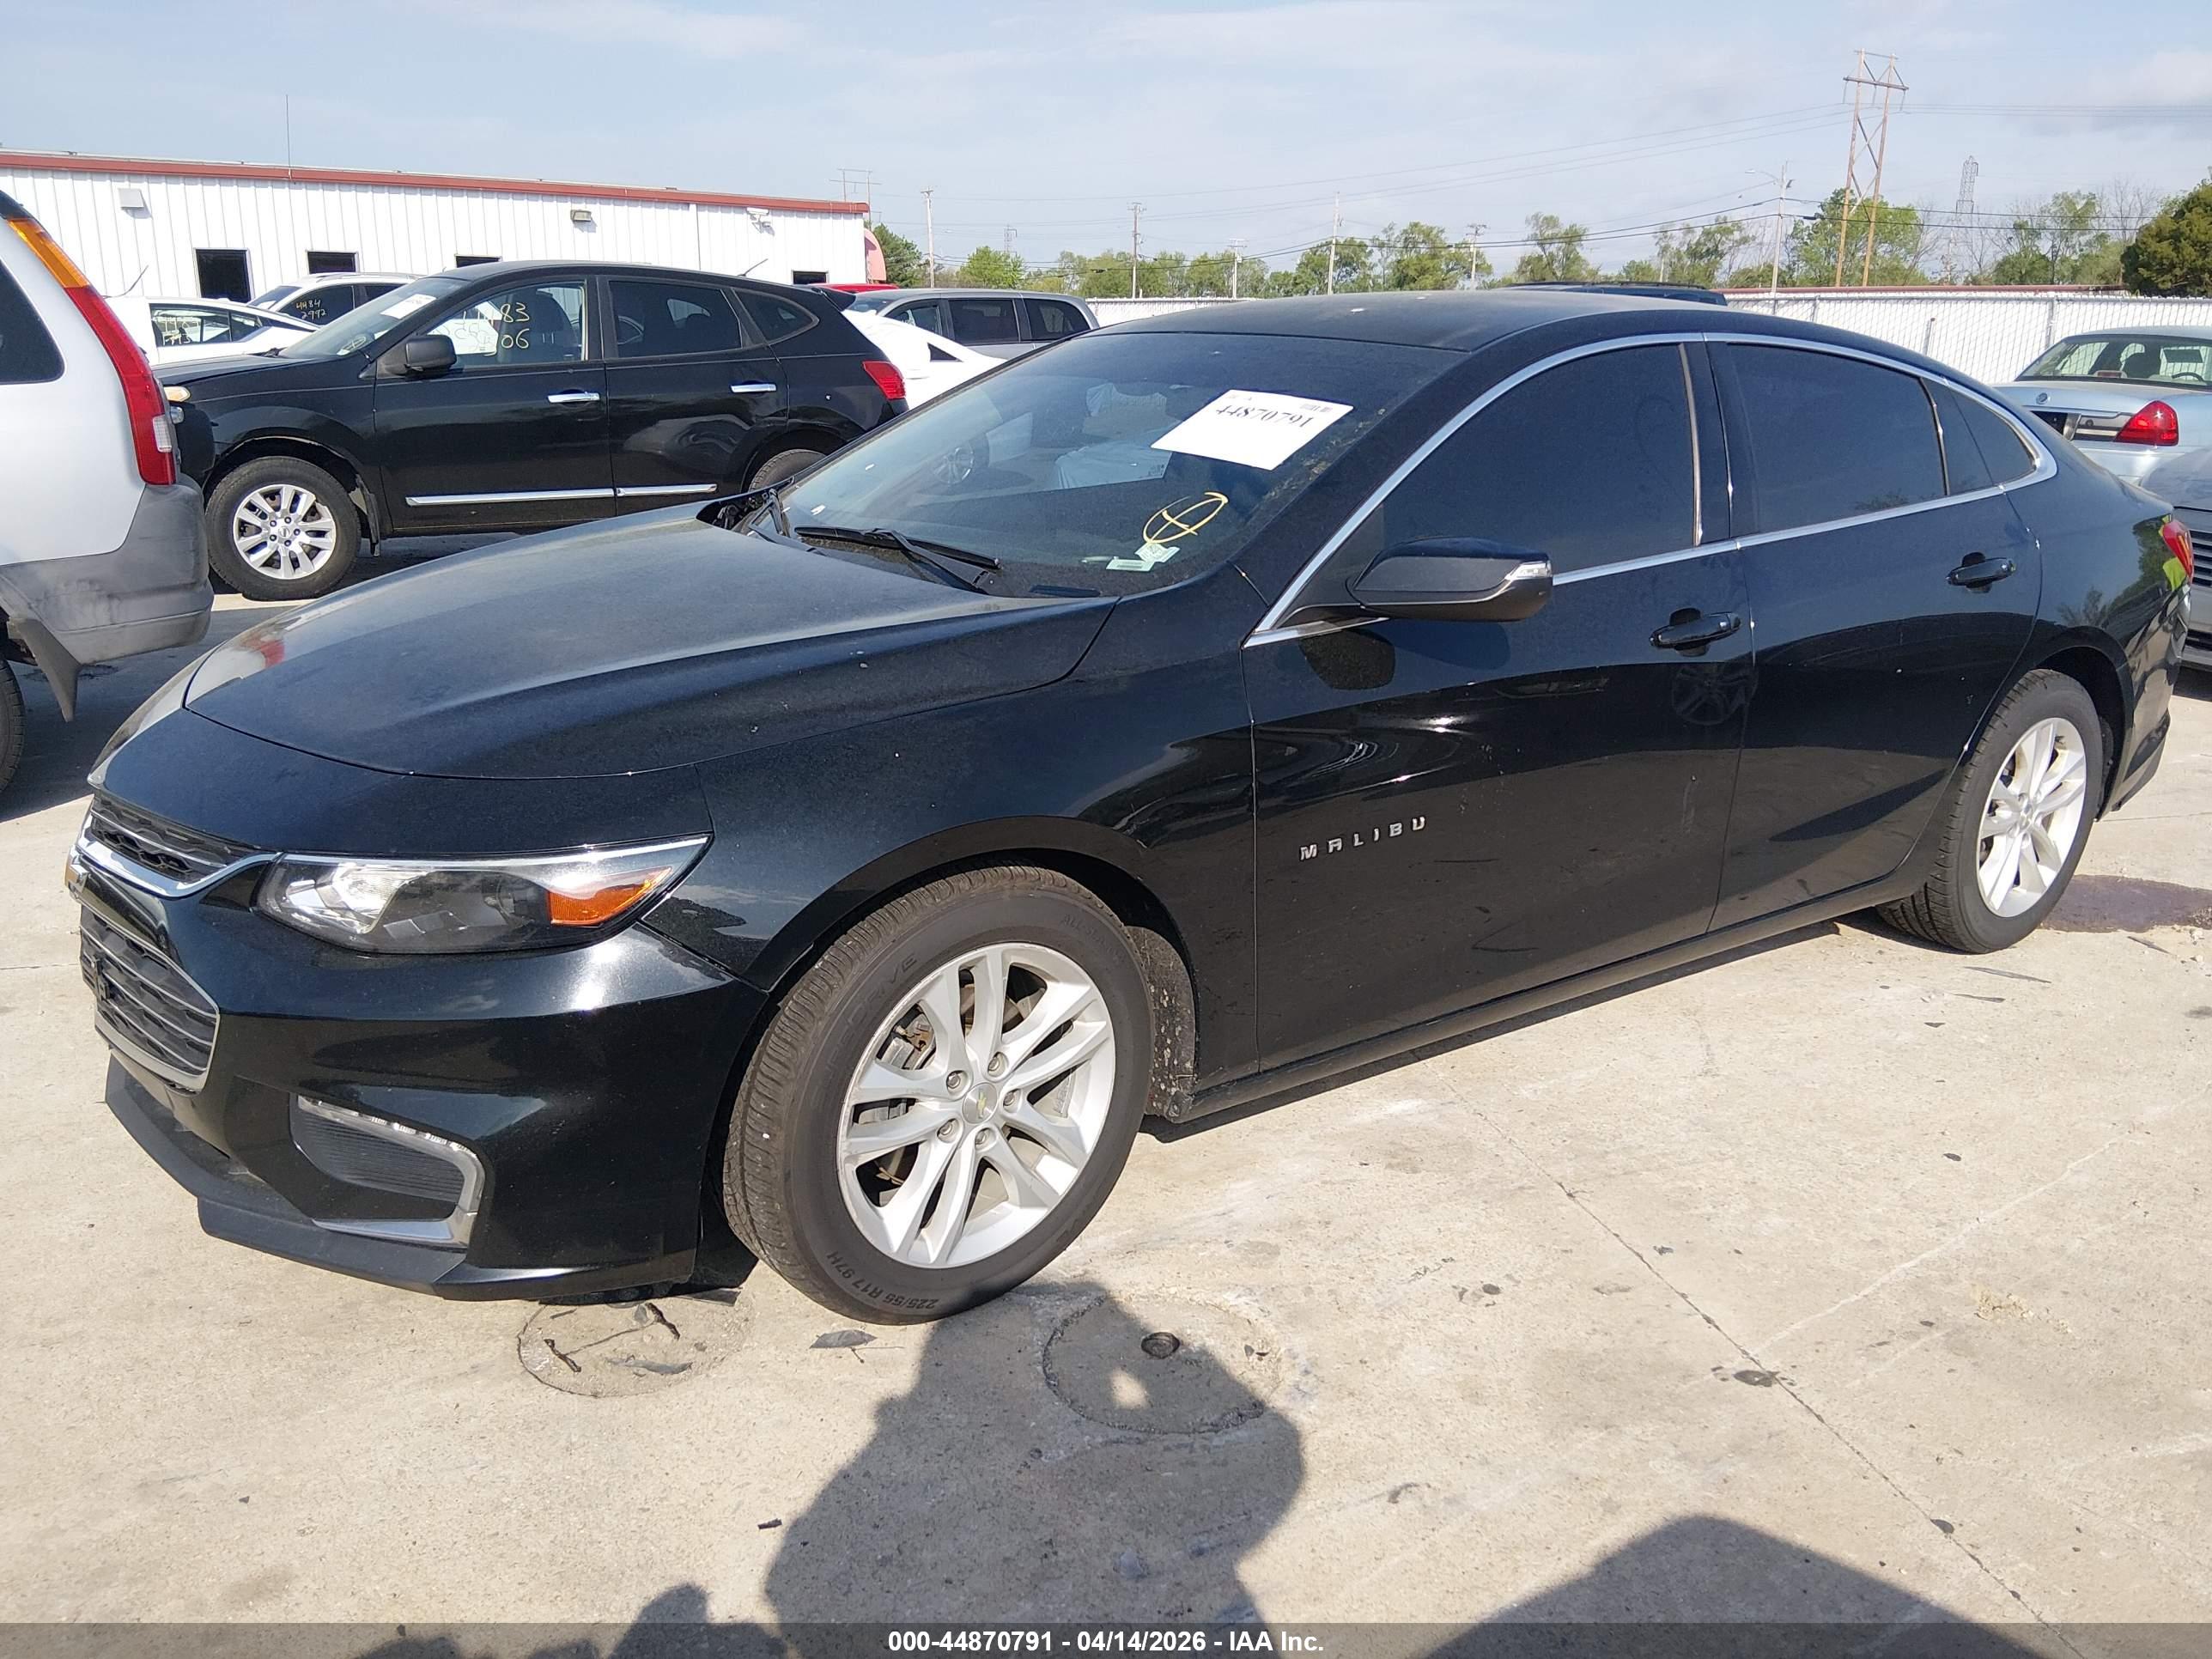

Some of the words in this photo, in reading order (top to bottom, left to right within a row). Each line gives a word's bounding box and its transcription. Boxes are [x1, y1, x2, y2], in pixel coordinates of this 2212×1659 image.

[1216, 404, 1314, 428] 44870791
[1299, 816, 1426, 860] MALIBU
[826, 1251, 855, 1279] 97H
[851, 1279, 884, 1299] R17
[883, 1293, 939, 1310] 225/55
